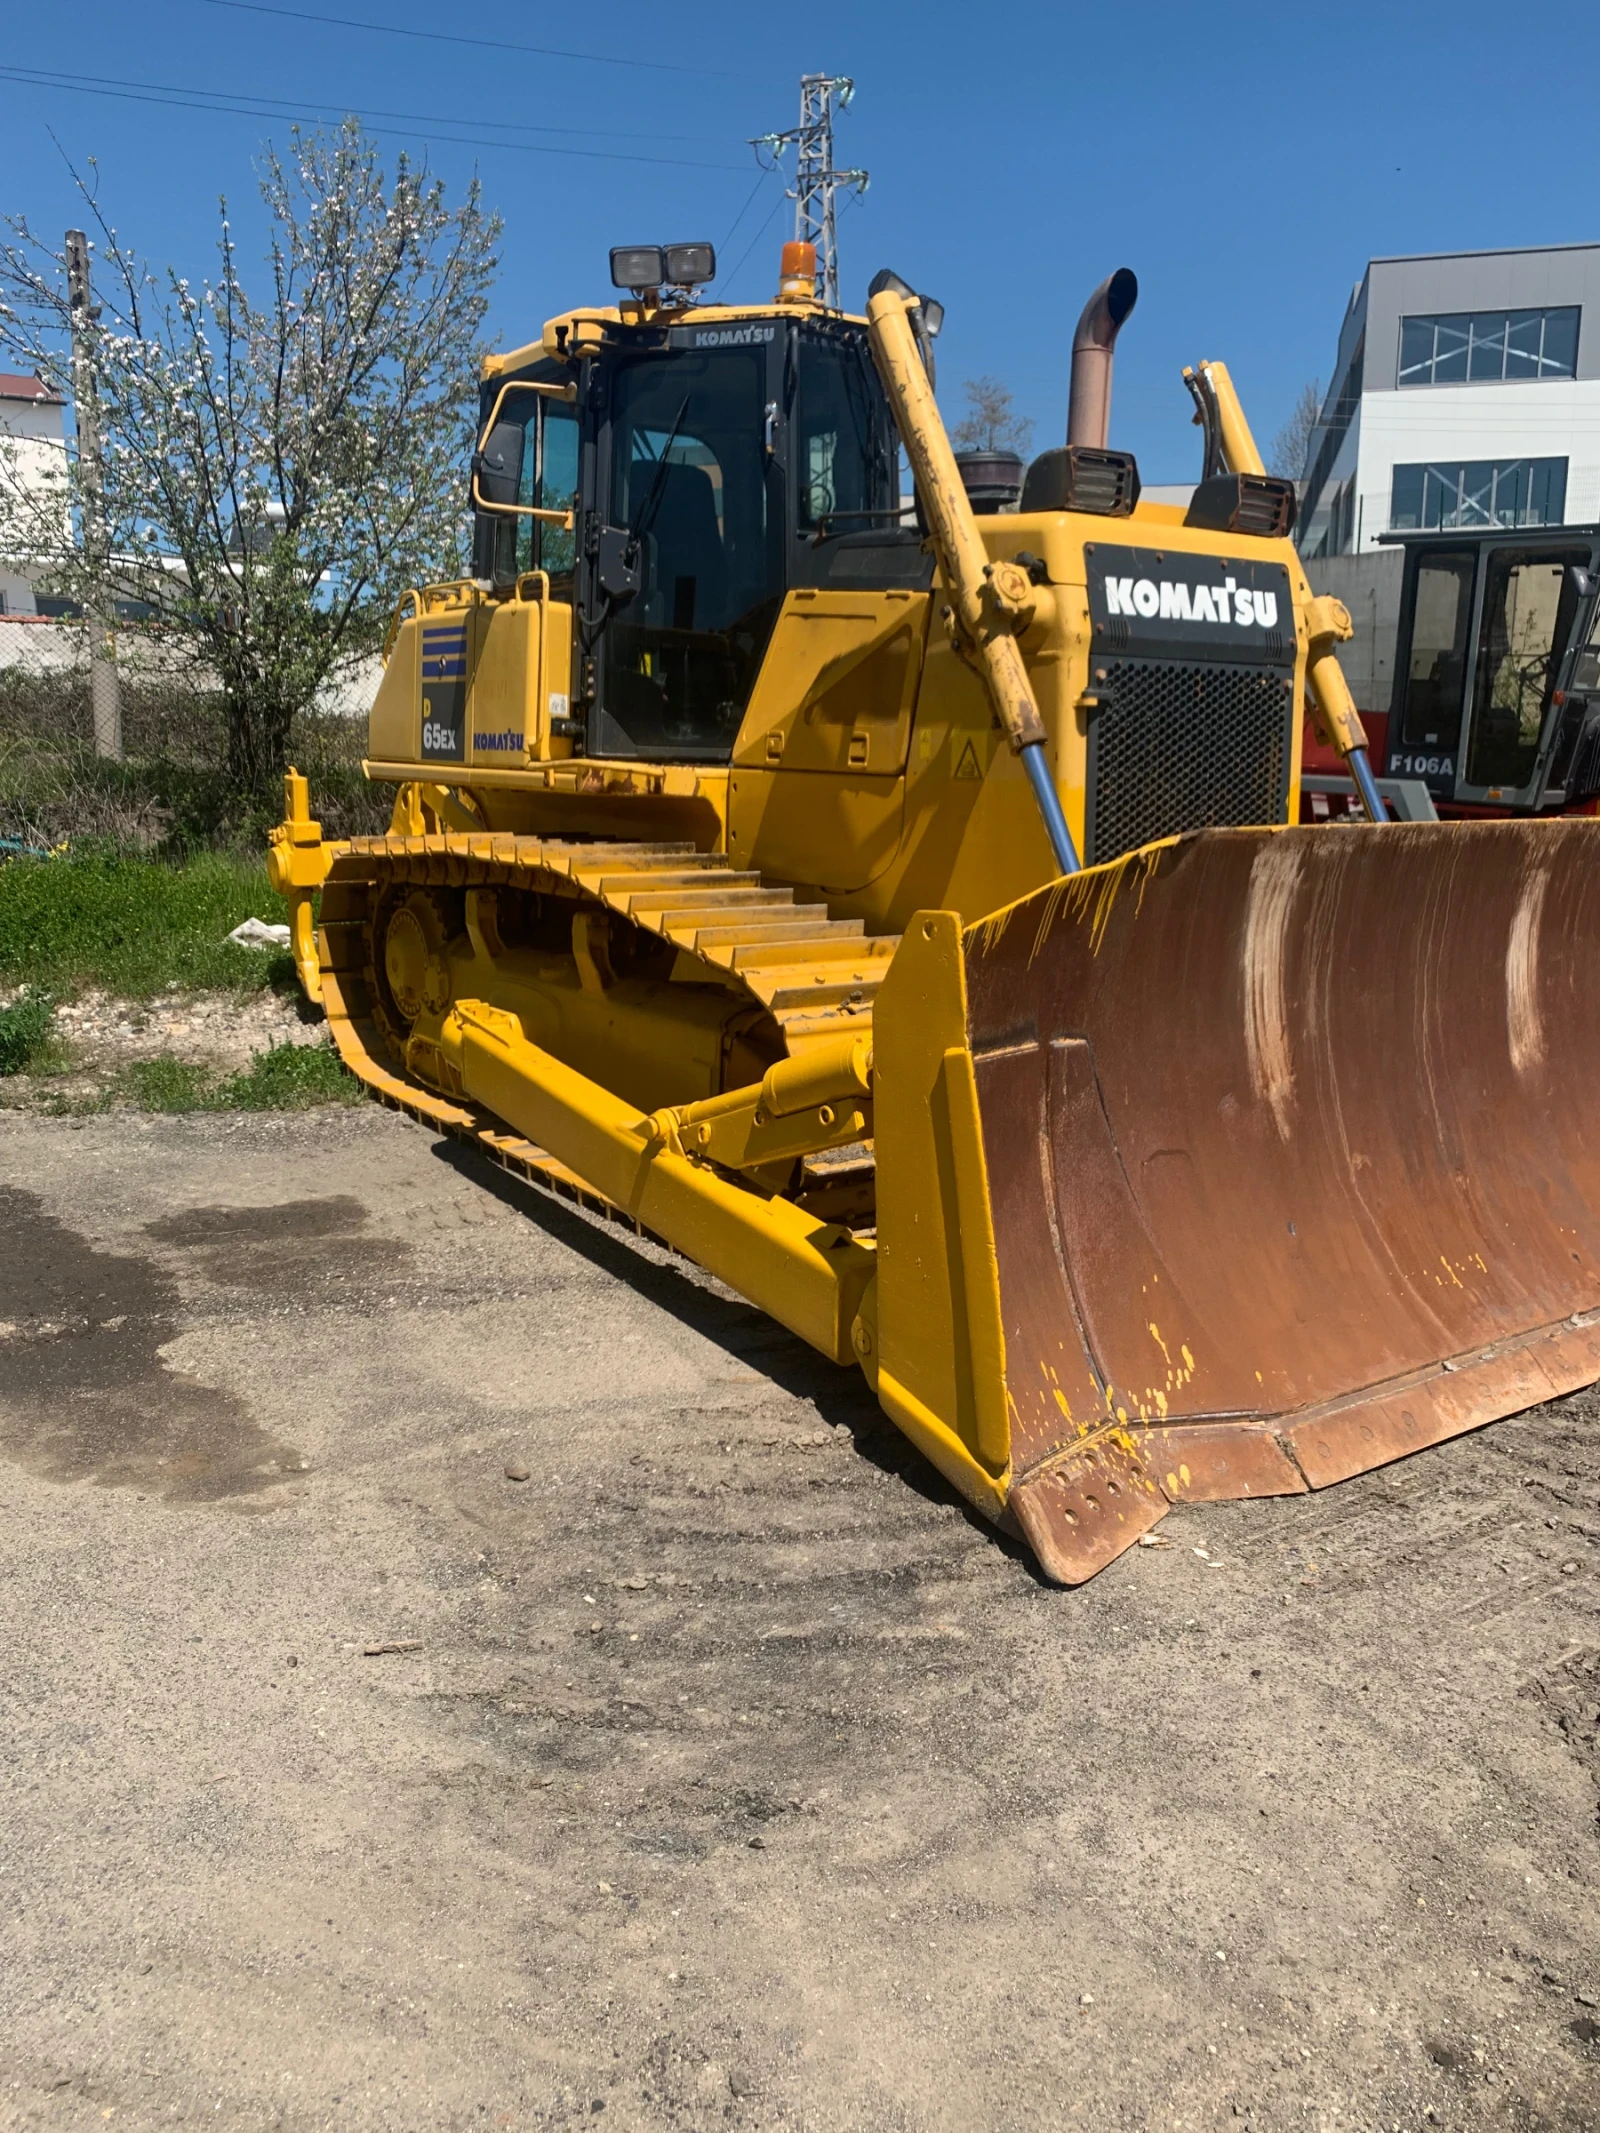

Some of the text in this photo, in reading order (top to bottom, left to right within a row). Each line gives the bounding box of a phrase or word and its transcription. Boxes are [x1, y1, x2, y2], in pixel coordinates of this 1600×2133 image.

[695, 325, 775, 346] KOMATSU
[1105, 576, 1278, 628] KOMATSU
[423, 698, 431, 718] D
[423, 722, 456, 750] 65EX
[473, 728, 524, 751] KOMATSU
[1390, 754, 1454, 775] F106A
